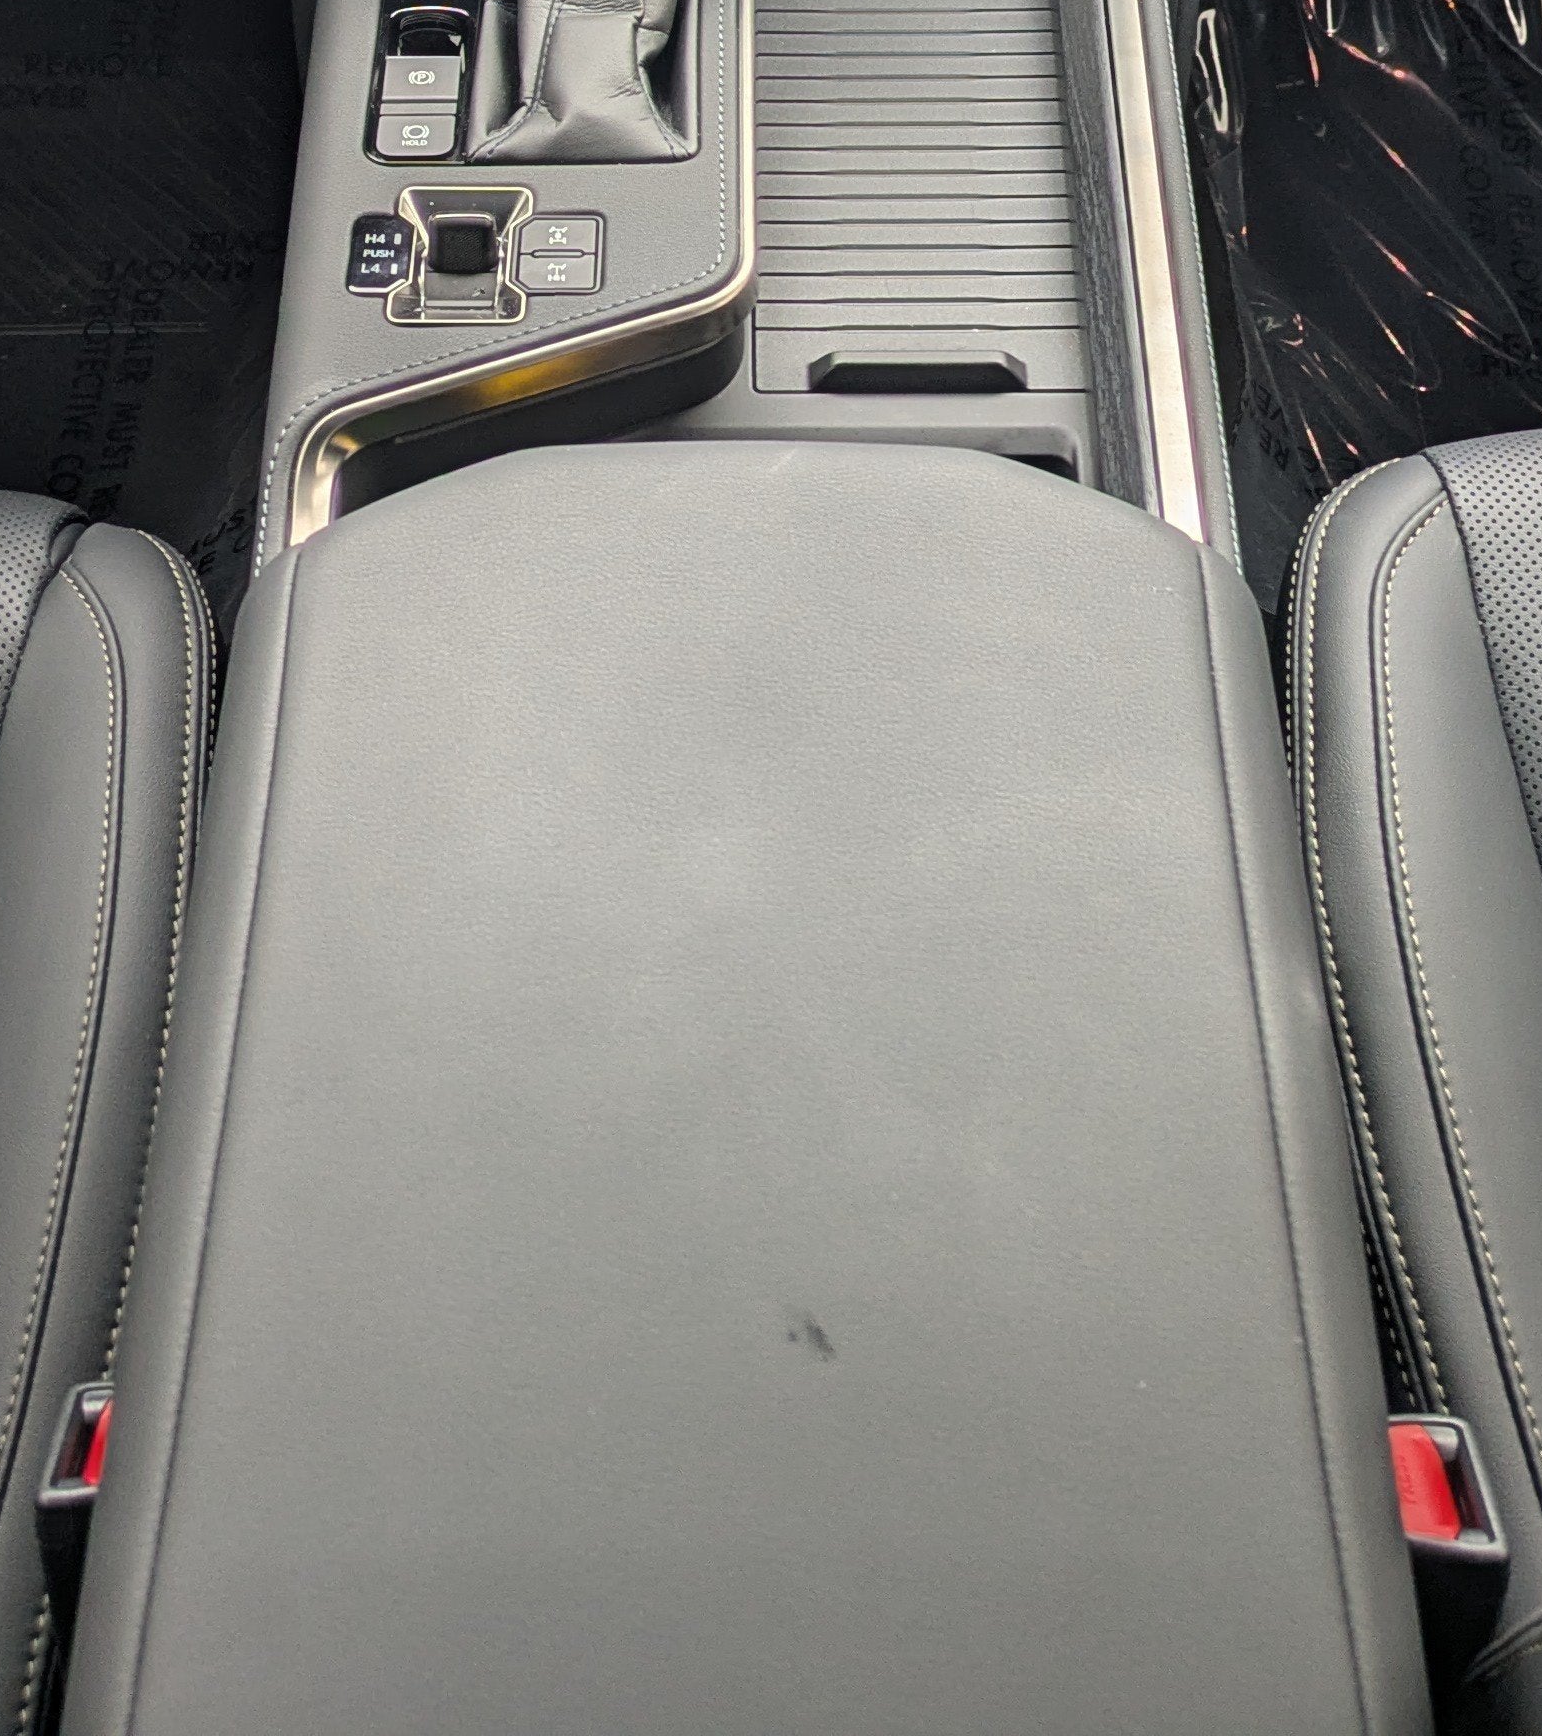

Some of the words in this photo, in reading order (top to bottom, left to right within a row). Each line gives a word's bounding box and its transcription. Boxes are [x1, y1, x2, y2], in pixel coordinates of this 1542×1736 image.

[401, 139, 428, 147] HOLD
[364, 233, 386, 244] H4
[362, 248, 395, 258] PUSH
[360, 262, 380, 274] L4
